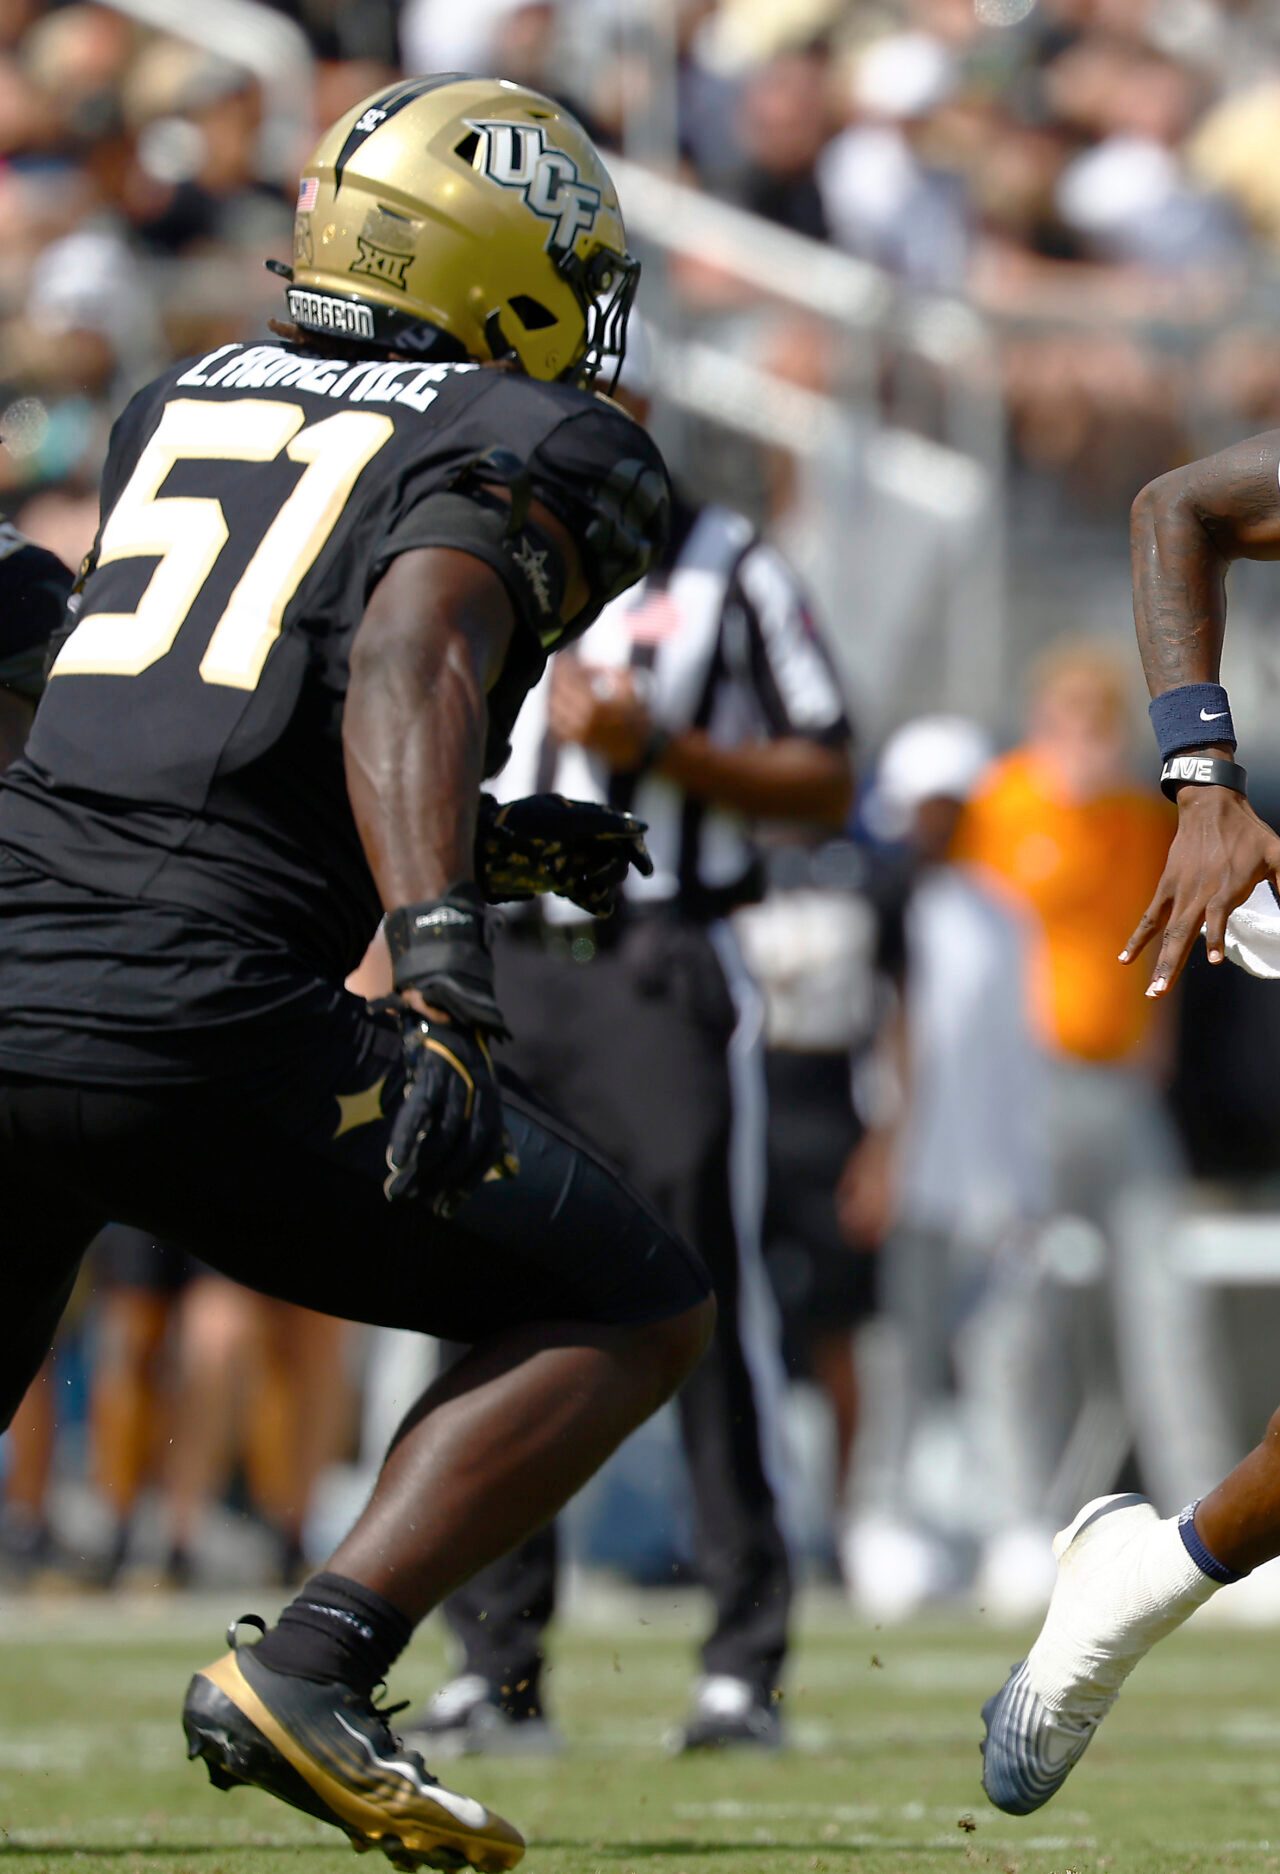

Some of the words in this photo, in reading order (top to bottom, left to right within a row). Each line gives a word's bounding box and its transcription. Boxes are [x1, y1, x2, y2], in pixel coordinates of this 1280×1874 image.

[462, 119, 602, 255] UCF
[48, 398, 394, 692] 51
[1160, 755, 1214, 782] LIVE
